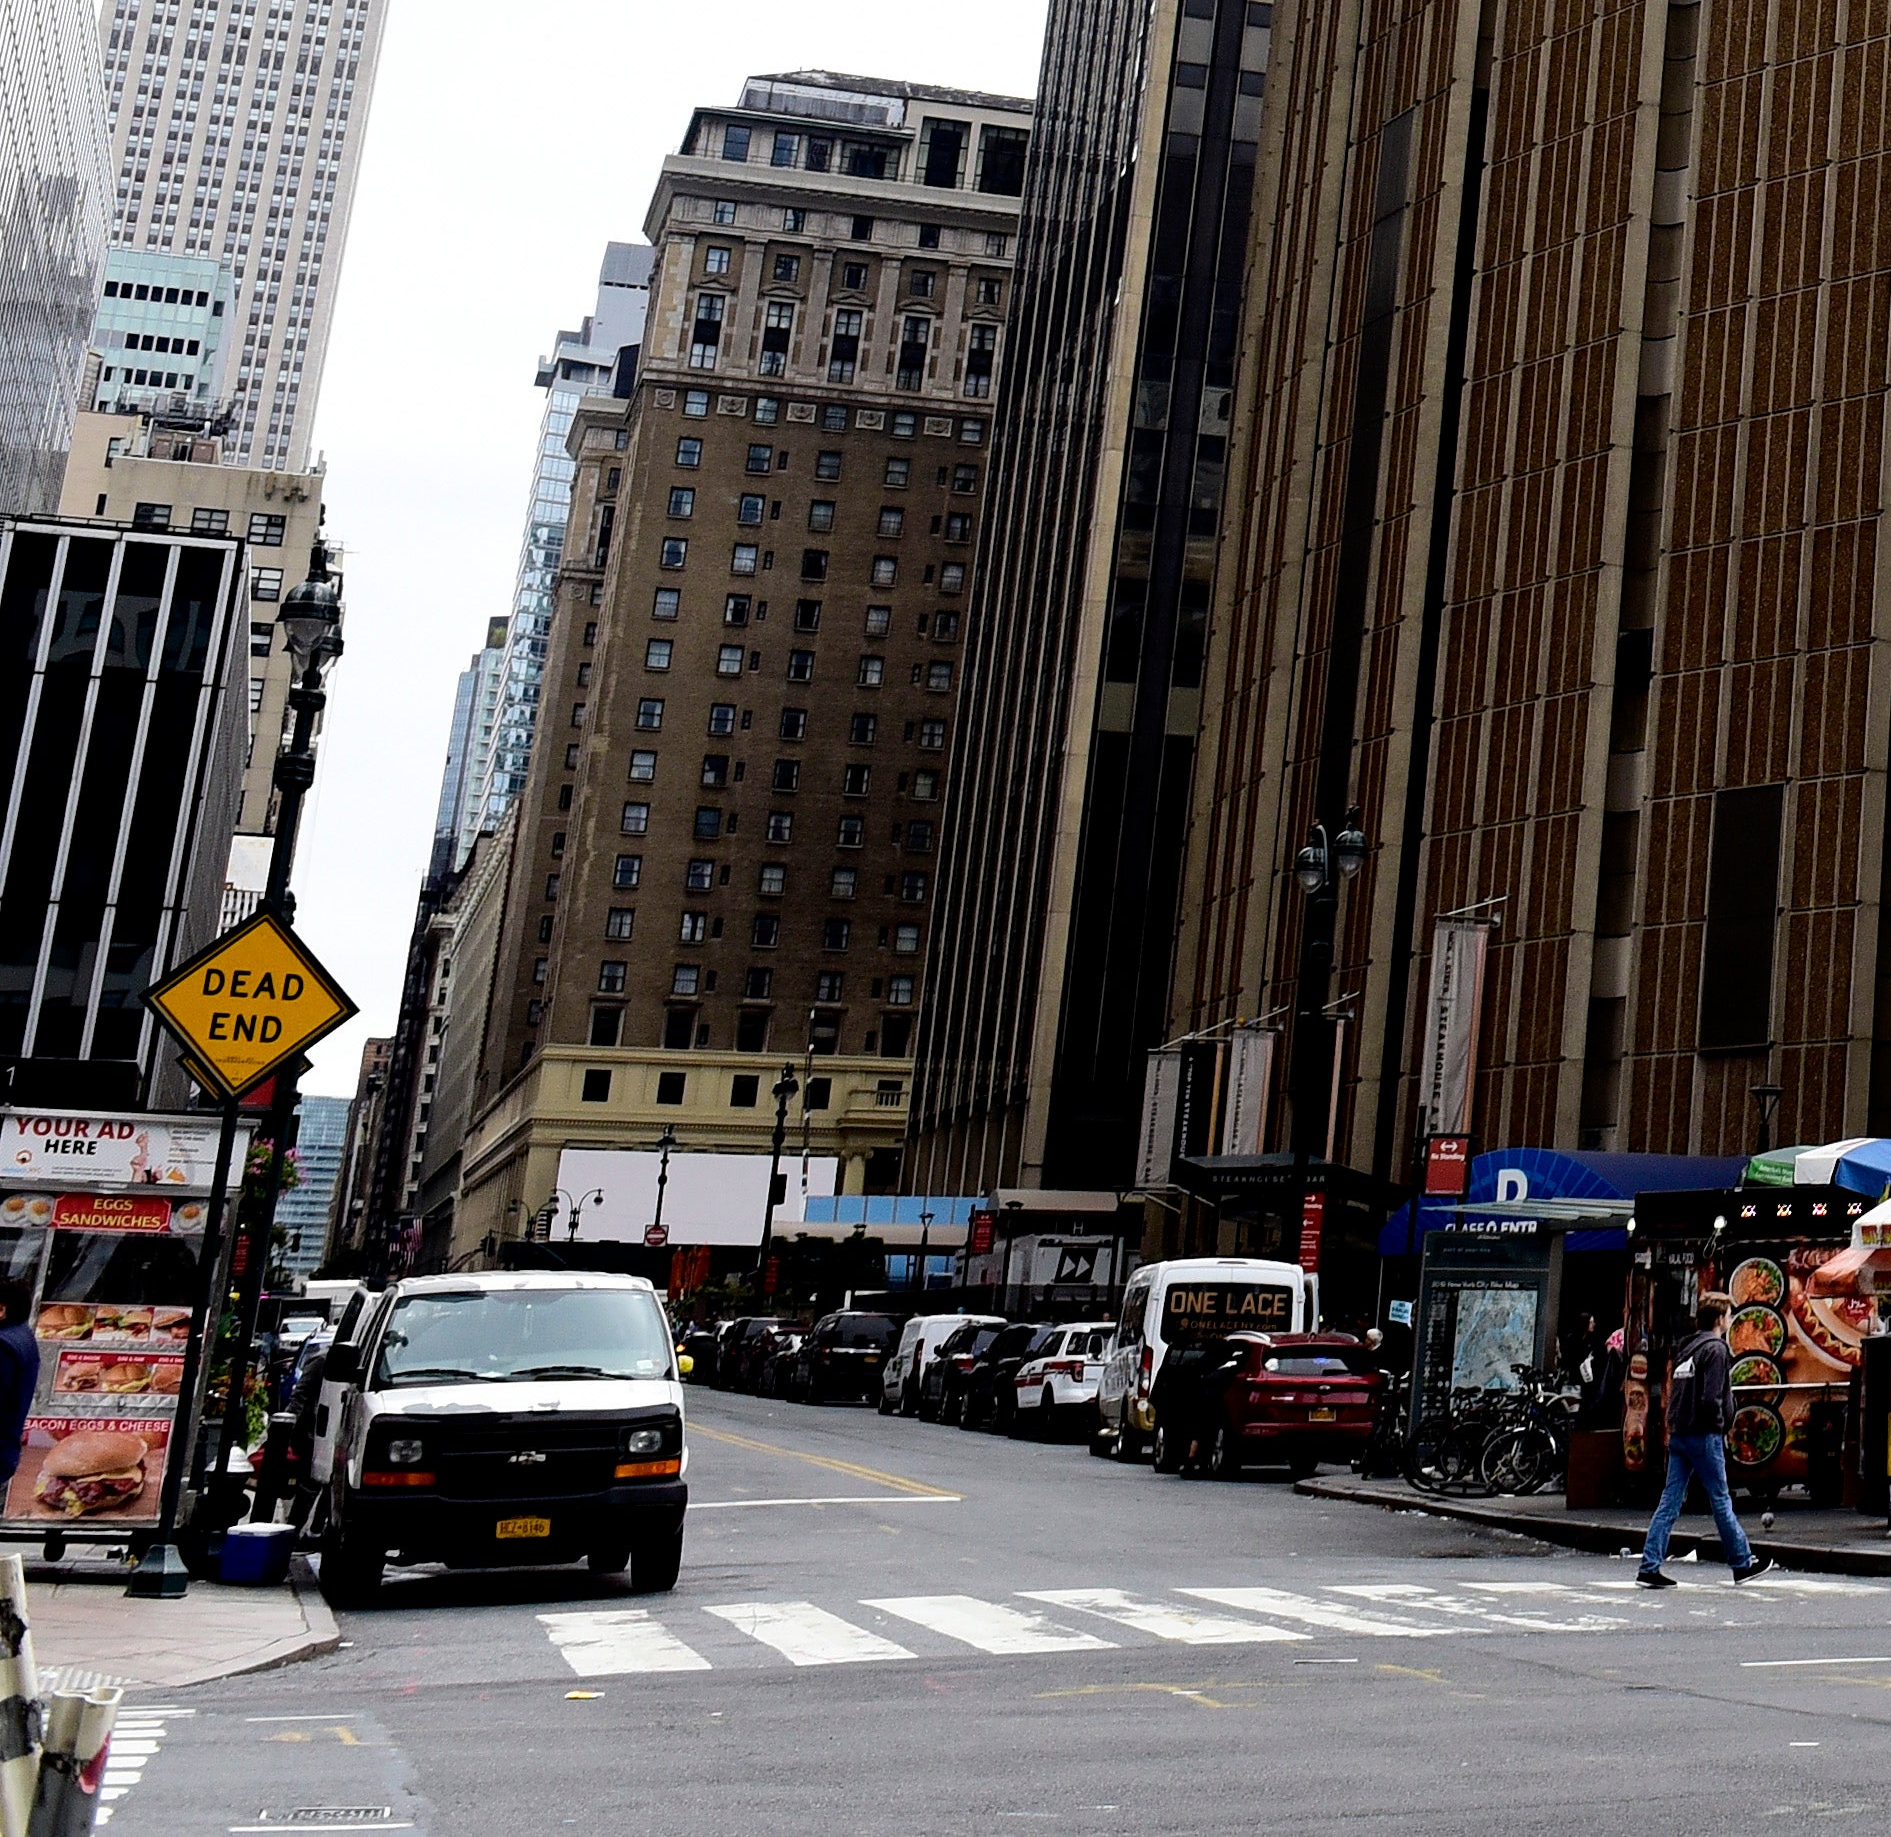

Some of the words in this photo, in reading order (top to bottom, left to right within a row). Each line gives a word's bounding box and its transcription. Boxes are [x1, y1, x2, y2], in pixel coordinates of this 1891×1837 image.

[202, 968, 305, 1001] DEAD
[208, 1013, 283, 1043] END
[1432, 1006, 1450, 1100] STEAKHOUSE
[15, 1117, 89, 1137] YOUR
[96, 1122, 136, 1141] AD
[44, 1139, 98, 1156] HERE
[1496, 1168, 1528, 1203] D
[93, 1198, 134, 1211] EGGS
[60, 1212, 162, 1229] SANDWICHES
[1476, 1281, 1490, 1289] City
[1504, 1281, 1520, 1289] Map
[1170, 1291, 1218, 1314] ONE
[1226, 1292, 1288, 1315] LACE
[23, 1420, 67, 1431] BACON
[70, 1420, 105, 1431] EGGS
[107, 1421, 116, 1432] &
[119, 1420, 169, 1433] CHEESE
